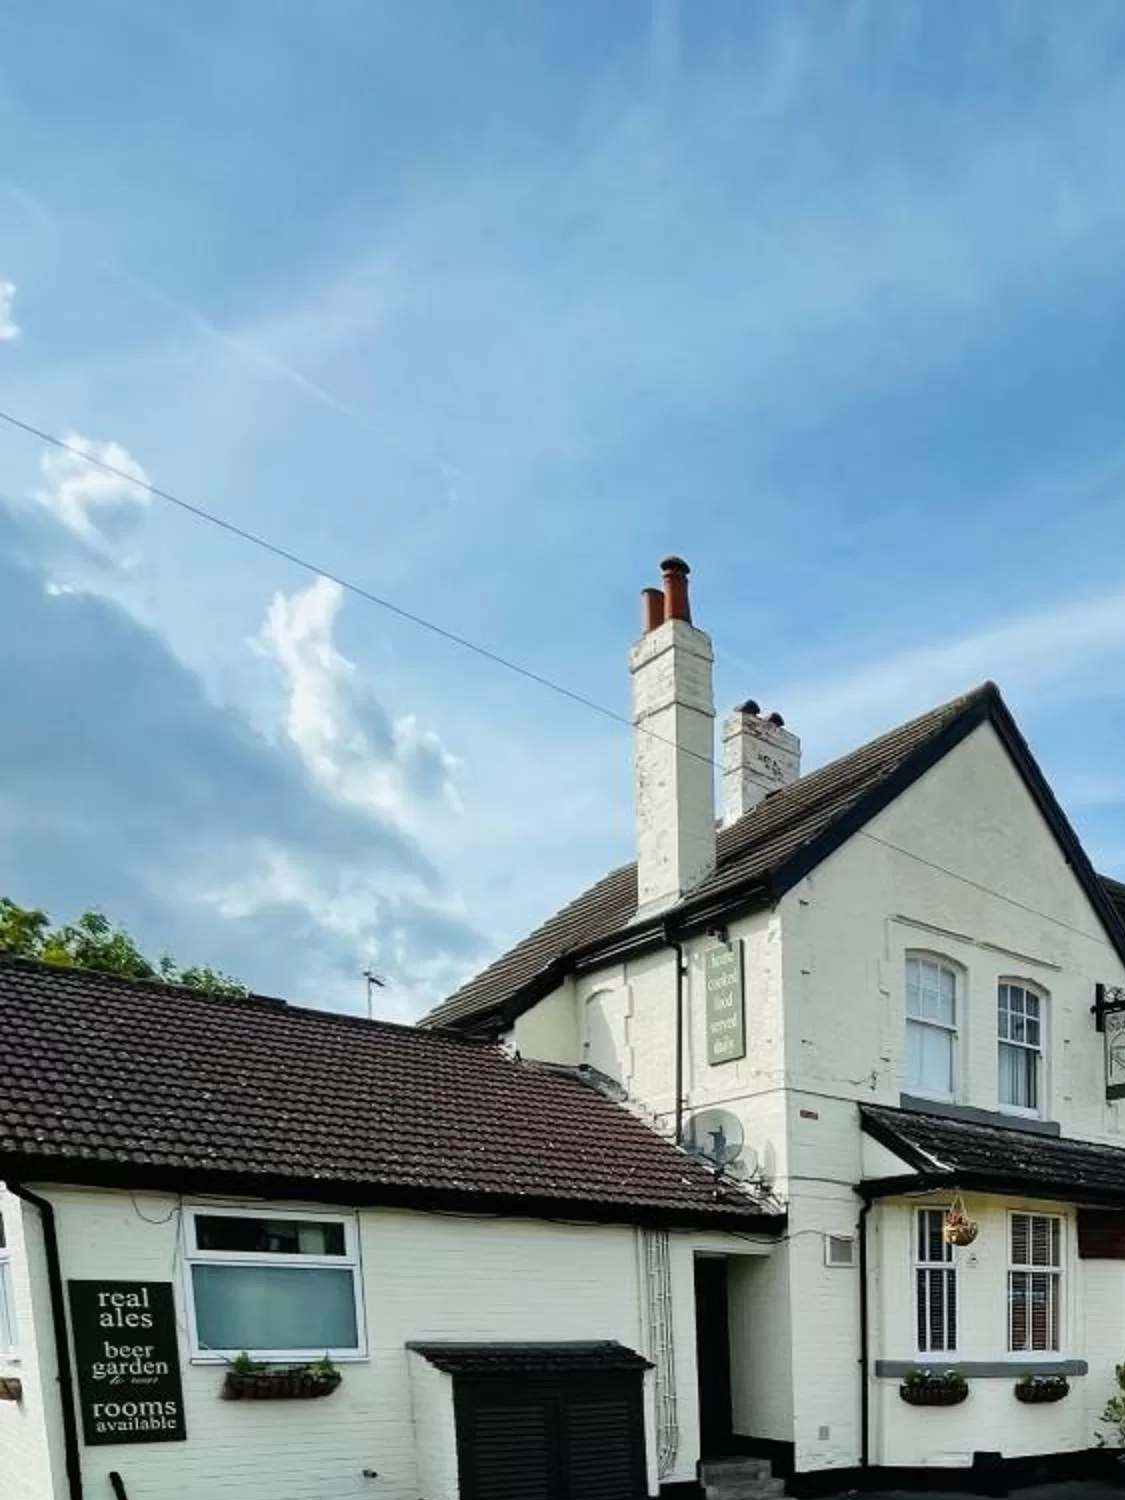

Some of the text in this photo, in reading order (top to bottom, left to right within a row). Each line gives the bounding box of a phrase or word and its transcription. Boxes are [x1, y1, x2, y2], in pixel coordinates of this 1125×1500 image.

[98, 1287, 150, 1308] real
[100, 1307, 153, 1328] ales
[103, 1340, 155, 1359] beer
[91, 1357, 169, 1380] garden
[92, 1400, 177, 1418] rooms
[96, 1415, 177, 1433] available
